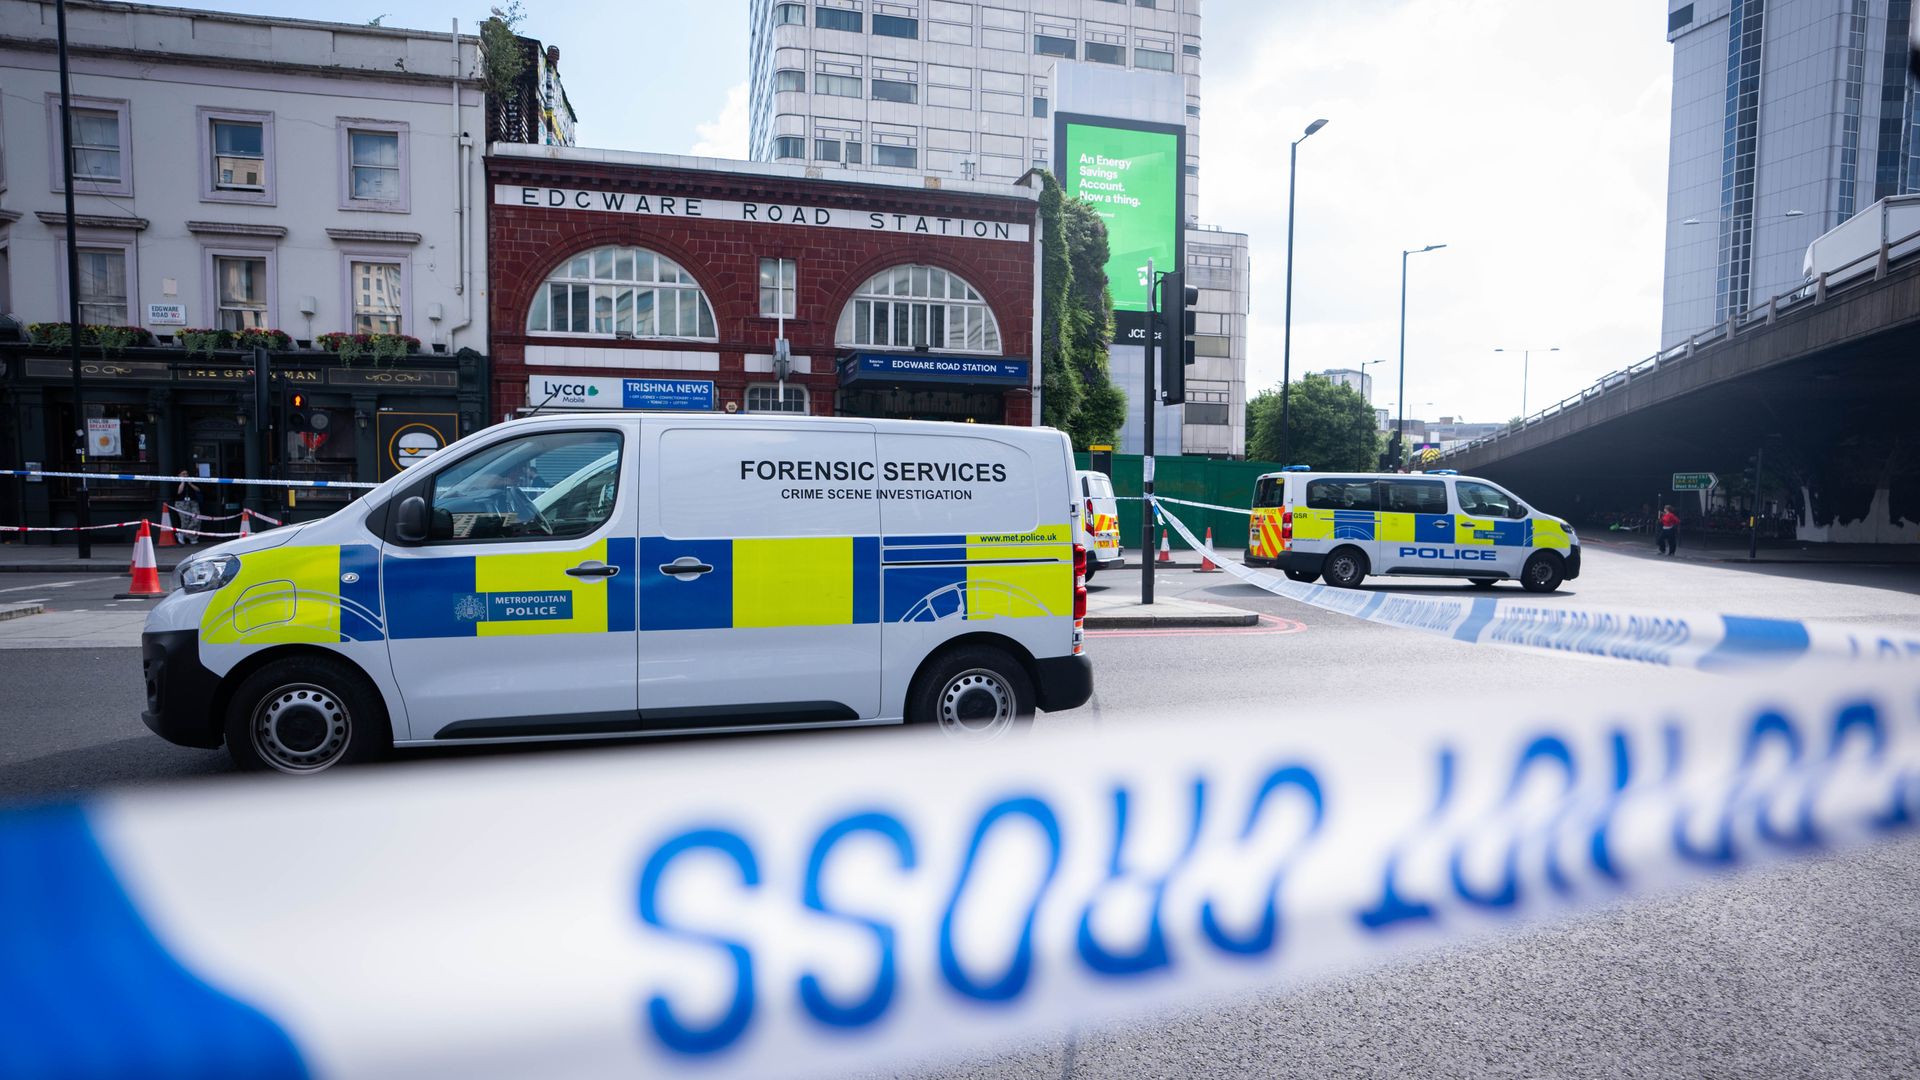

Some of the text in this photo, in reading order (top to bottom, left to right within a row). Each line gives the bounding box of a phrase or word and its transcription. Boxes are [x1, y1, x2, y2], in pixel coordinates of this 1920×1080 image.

[1079, 153, 1132, 170] An Energy
[1079, 166, 1118, 180] Savings
[1079, 178, 1126, 192] Account.
[1079, 190, 1141, 207] Now a thing.
[743, 202, 830, 225] ROAD
[870, 213, 1009, 240] STATION
[892, 360, 997, 373] EDGWARE ROAD STATION
[284, 370, 317, 380] MAN
[544, 381, 585, 398] Lyca
[626, 382, 709, 394] TRISHNA NEWS
[740, 460, 1007, 482] FORENSIC SERVICES
[781, 488, 972, 500] CRIME SCENE INVESTIGATION
[980, 533, 1057, 544] www.met.police.uk
[1399, 547, 1497, 561] POLICE
[495, 594, 567, 604] METROPOLITAN
[505, 606, 558, 616] POLICE
